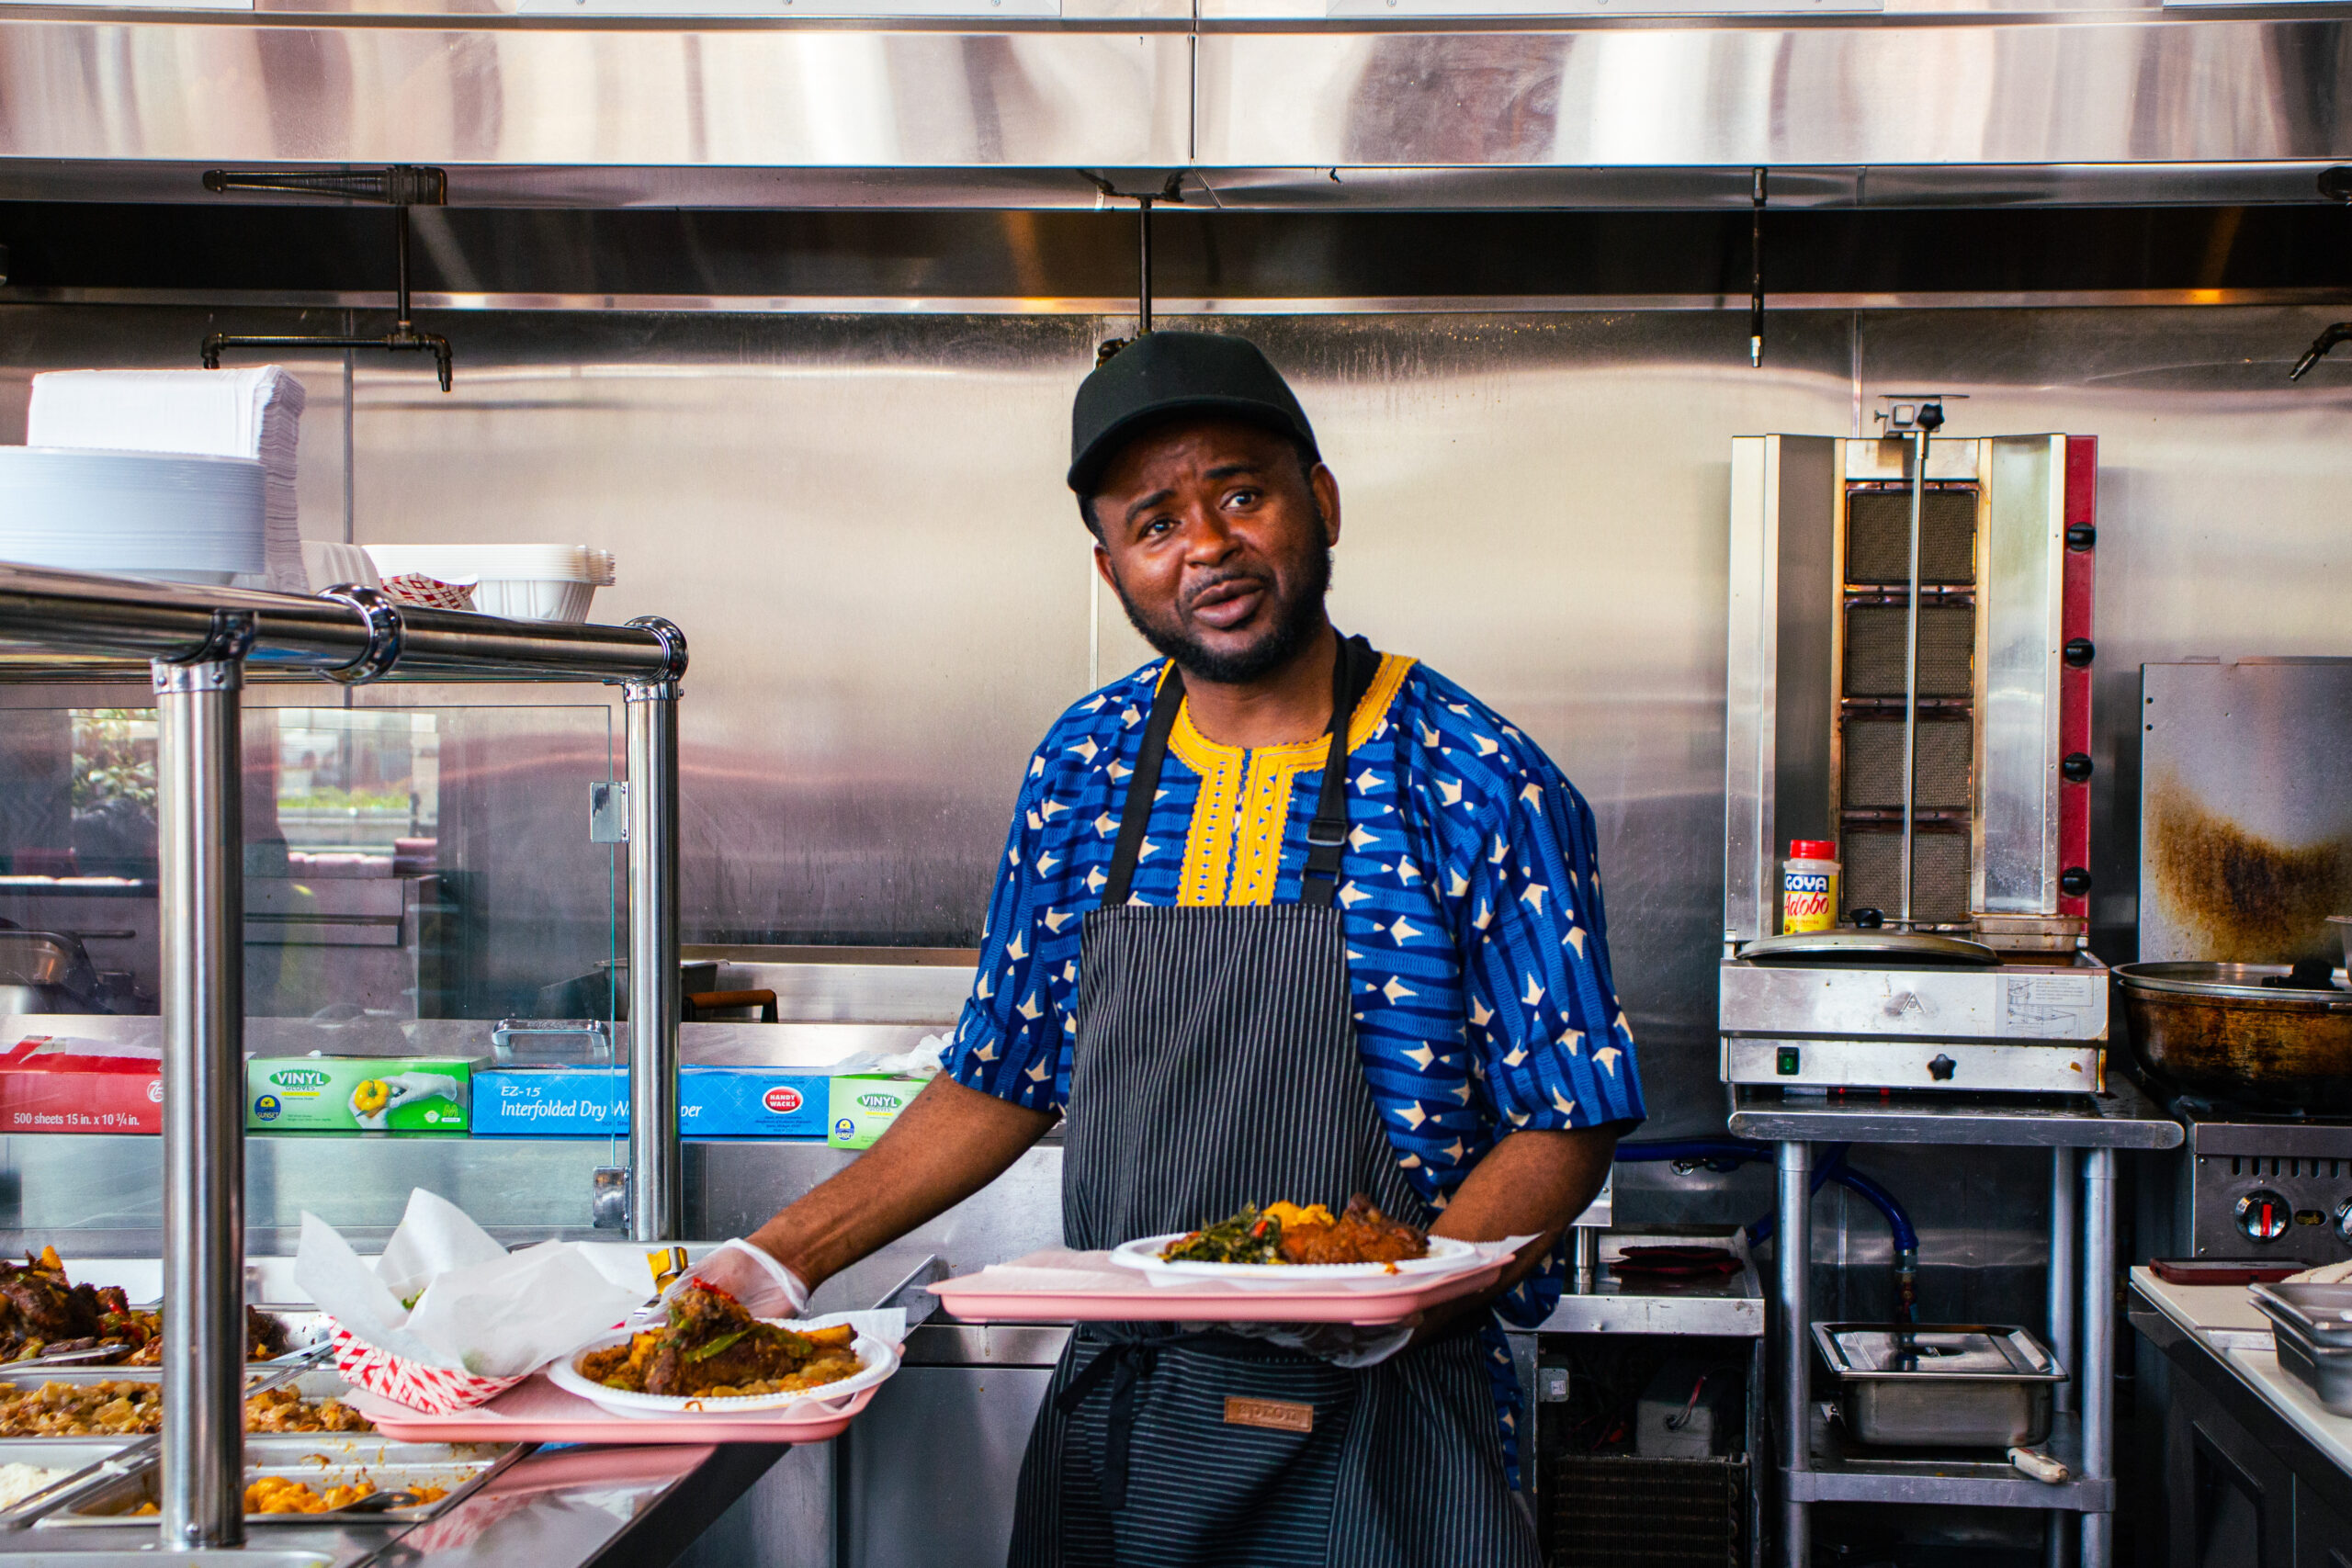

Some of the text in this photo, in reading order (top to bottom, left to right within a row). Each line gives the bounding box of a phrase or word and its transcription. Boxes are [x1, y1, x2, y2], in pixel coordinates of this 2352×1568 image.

[1785, 875, 1827, 891] GOYA
[1783, 891, 1829, 917] Adobo
[277, 1072, 324, 1084] VINYL
[501, 1086, 542, 1097] EZ-15
[862, 1096, 898, 1107] VINYL
[501, 1100, 577, 1122] Interfolded
[580, 1100, 606, 1122] Dry
[14, 1112, 32, 1124] 500
[34, 1112, 63, 1125] sheets
[66, 1113, 78, 1125] 15
[80, 1113, 92, 1125] in.
[94, 1116, 99, 1124] x
[102, 1114, 114, 1125] 10
[128, 1114, 140, 1126] in.
